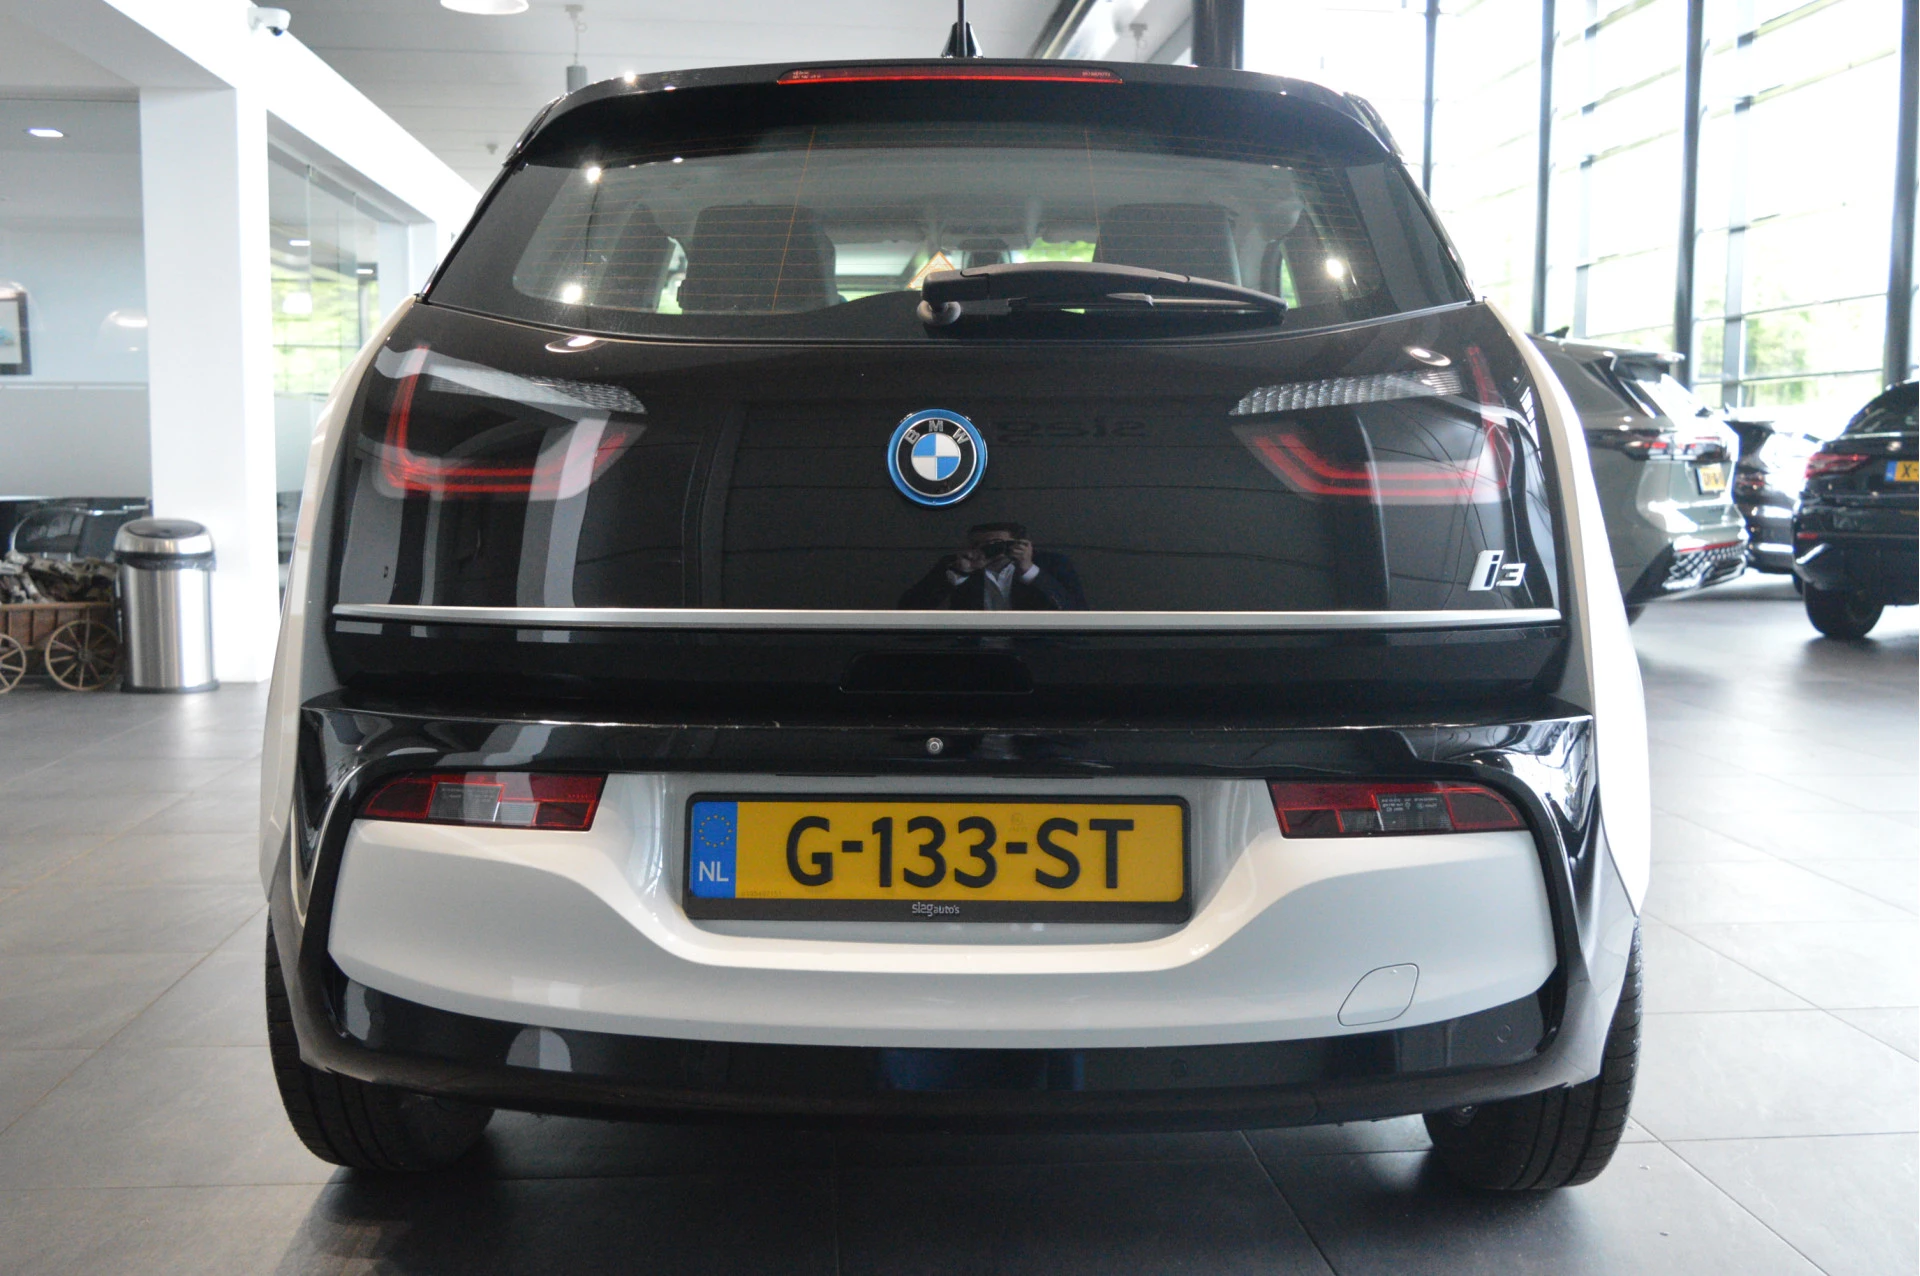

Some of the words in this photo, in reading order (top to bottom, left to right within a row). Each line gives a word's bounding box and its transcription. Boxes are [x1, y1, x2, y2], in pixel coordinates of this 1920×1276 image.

[904, 420, 970, 445] BMW
[1468, 550, 1526, 591] i3
[786, 815, 1134, 889] G-133-ST
[699, 861, 729, 882] NL
